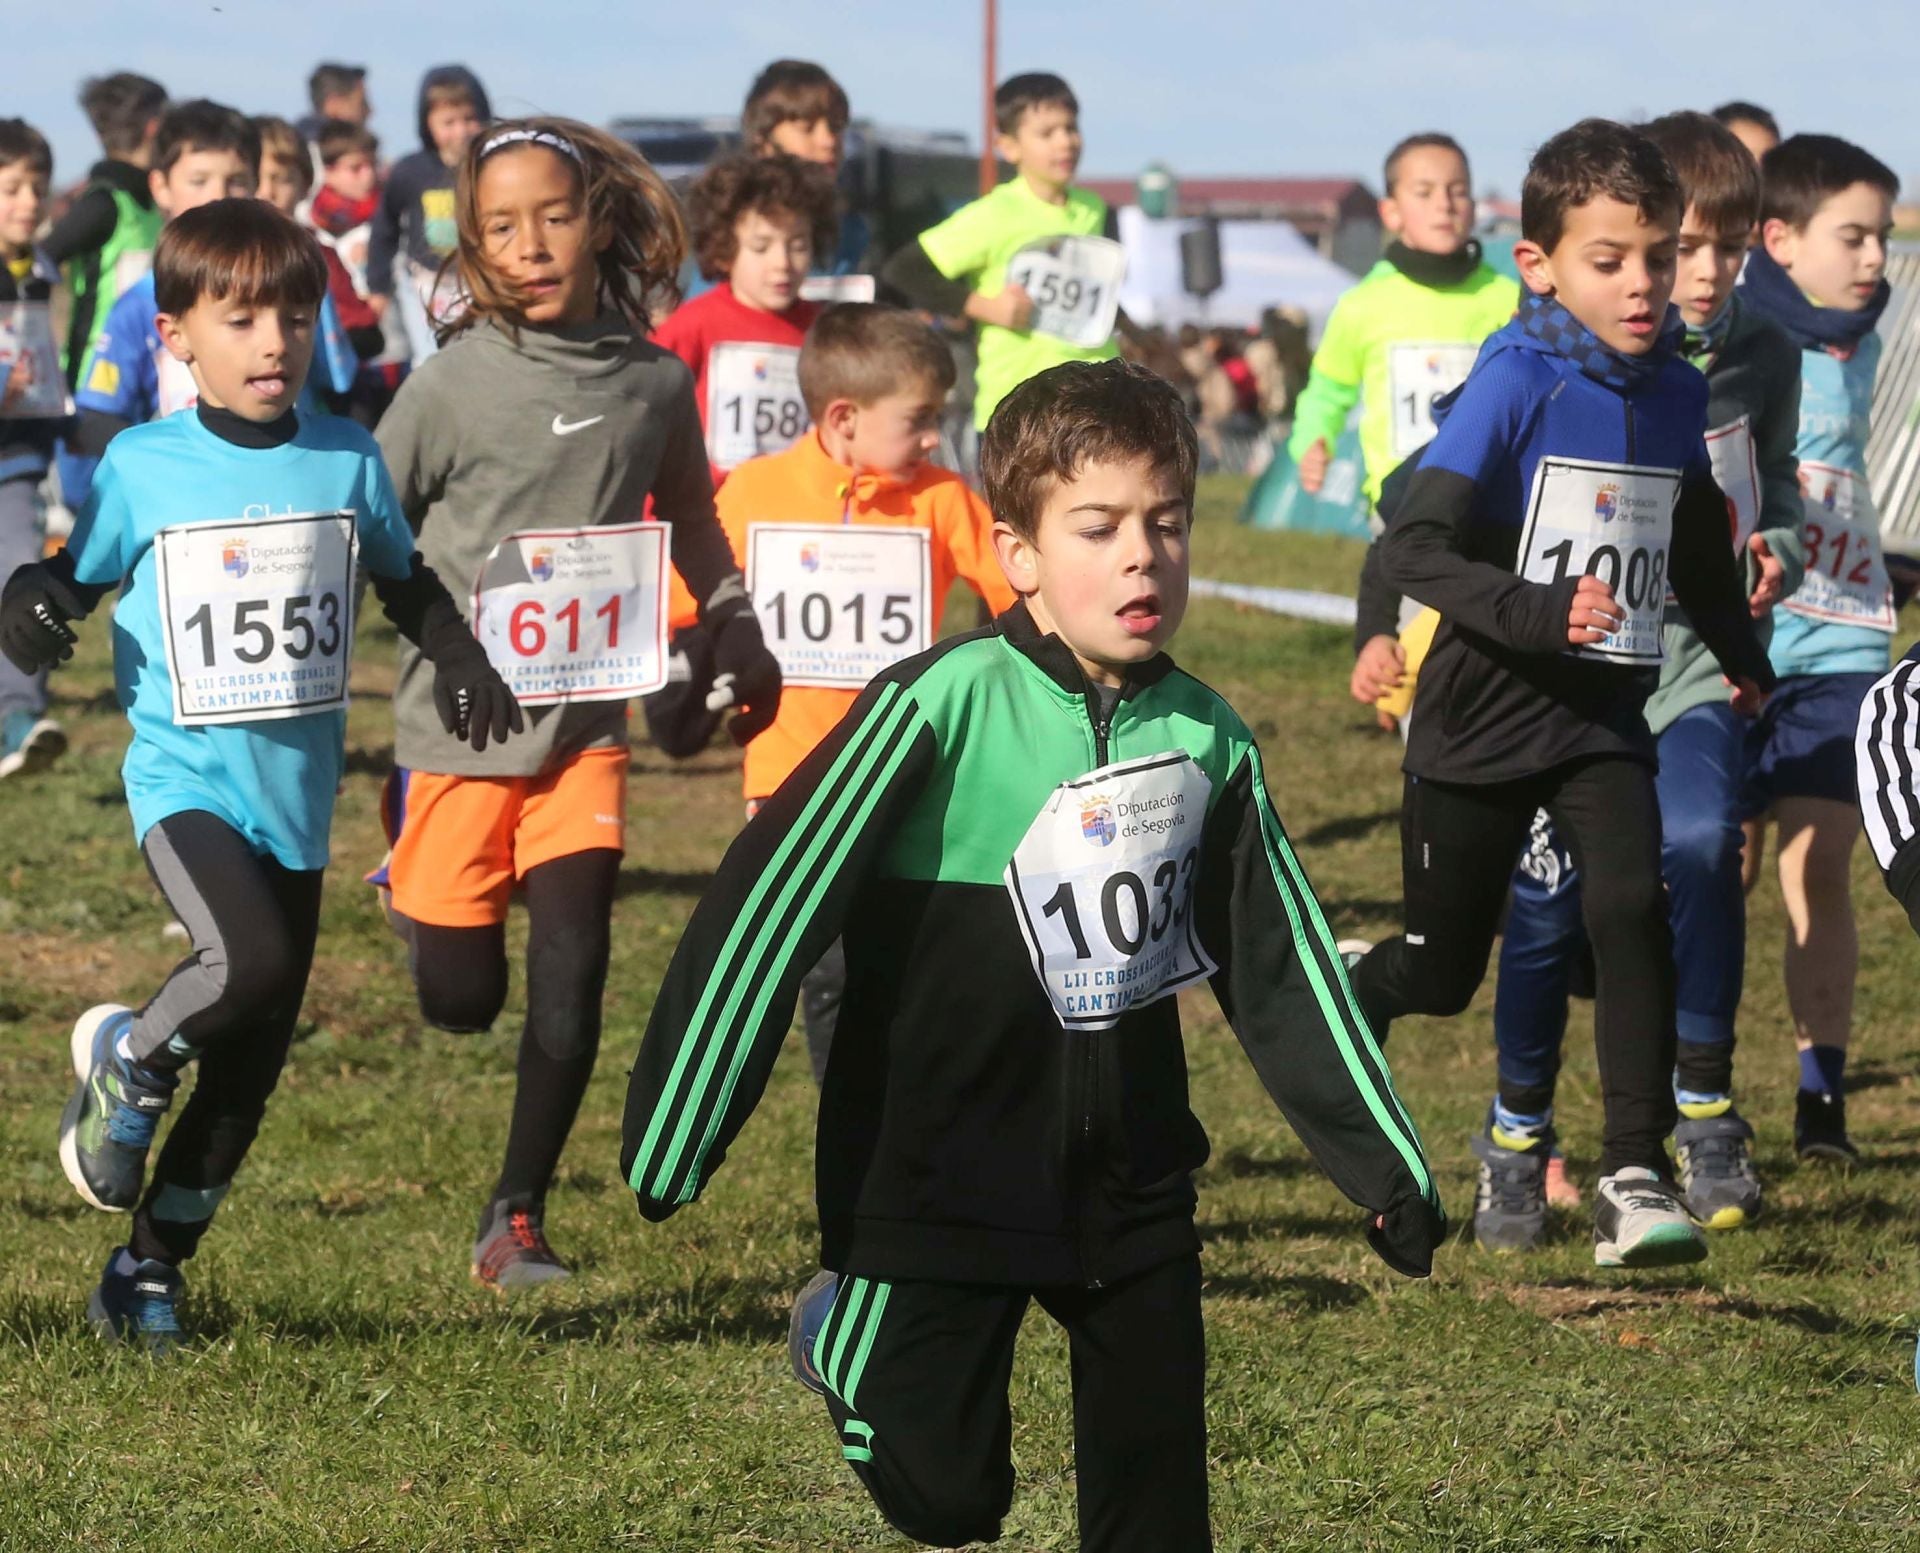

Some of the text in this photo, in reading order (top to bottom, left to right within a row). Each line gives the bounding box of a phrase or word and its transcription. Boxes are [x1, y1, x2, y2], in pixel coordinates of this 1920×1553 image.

[1020, 268, 1101, 318] 1591
[251, 544, 313, 560] Diputación
[252, 560, 313, 575] de Segovia
[1541, 538, 1665, 612] 1008
[184, 592, 341, 668] 1553
[509, 594, 621, 657] 611
[765, 590, 914, 645] 1015
[219, 672, 264, 688] CROSS
[1116, 791, 1185, 818] Diputación
[1121, 813, 1186, 838] de Segovia
[1042, 845, 1198, 960] 1033
[1064, 972, 1089, 989] LII
[1095, 965, 1138, 986] CROSS
